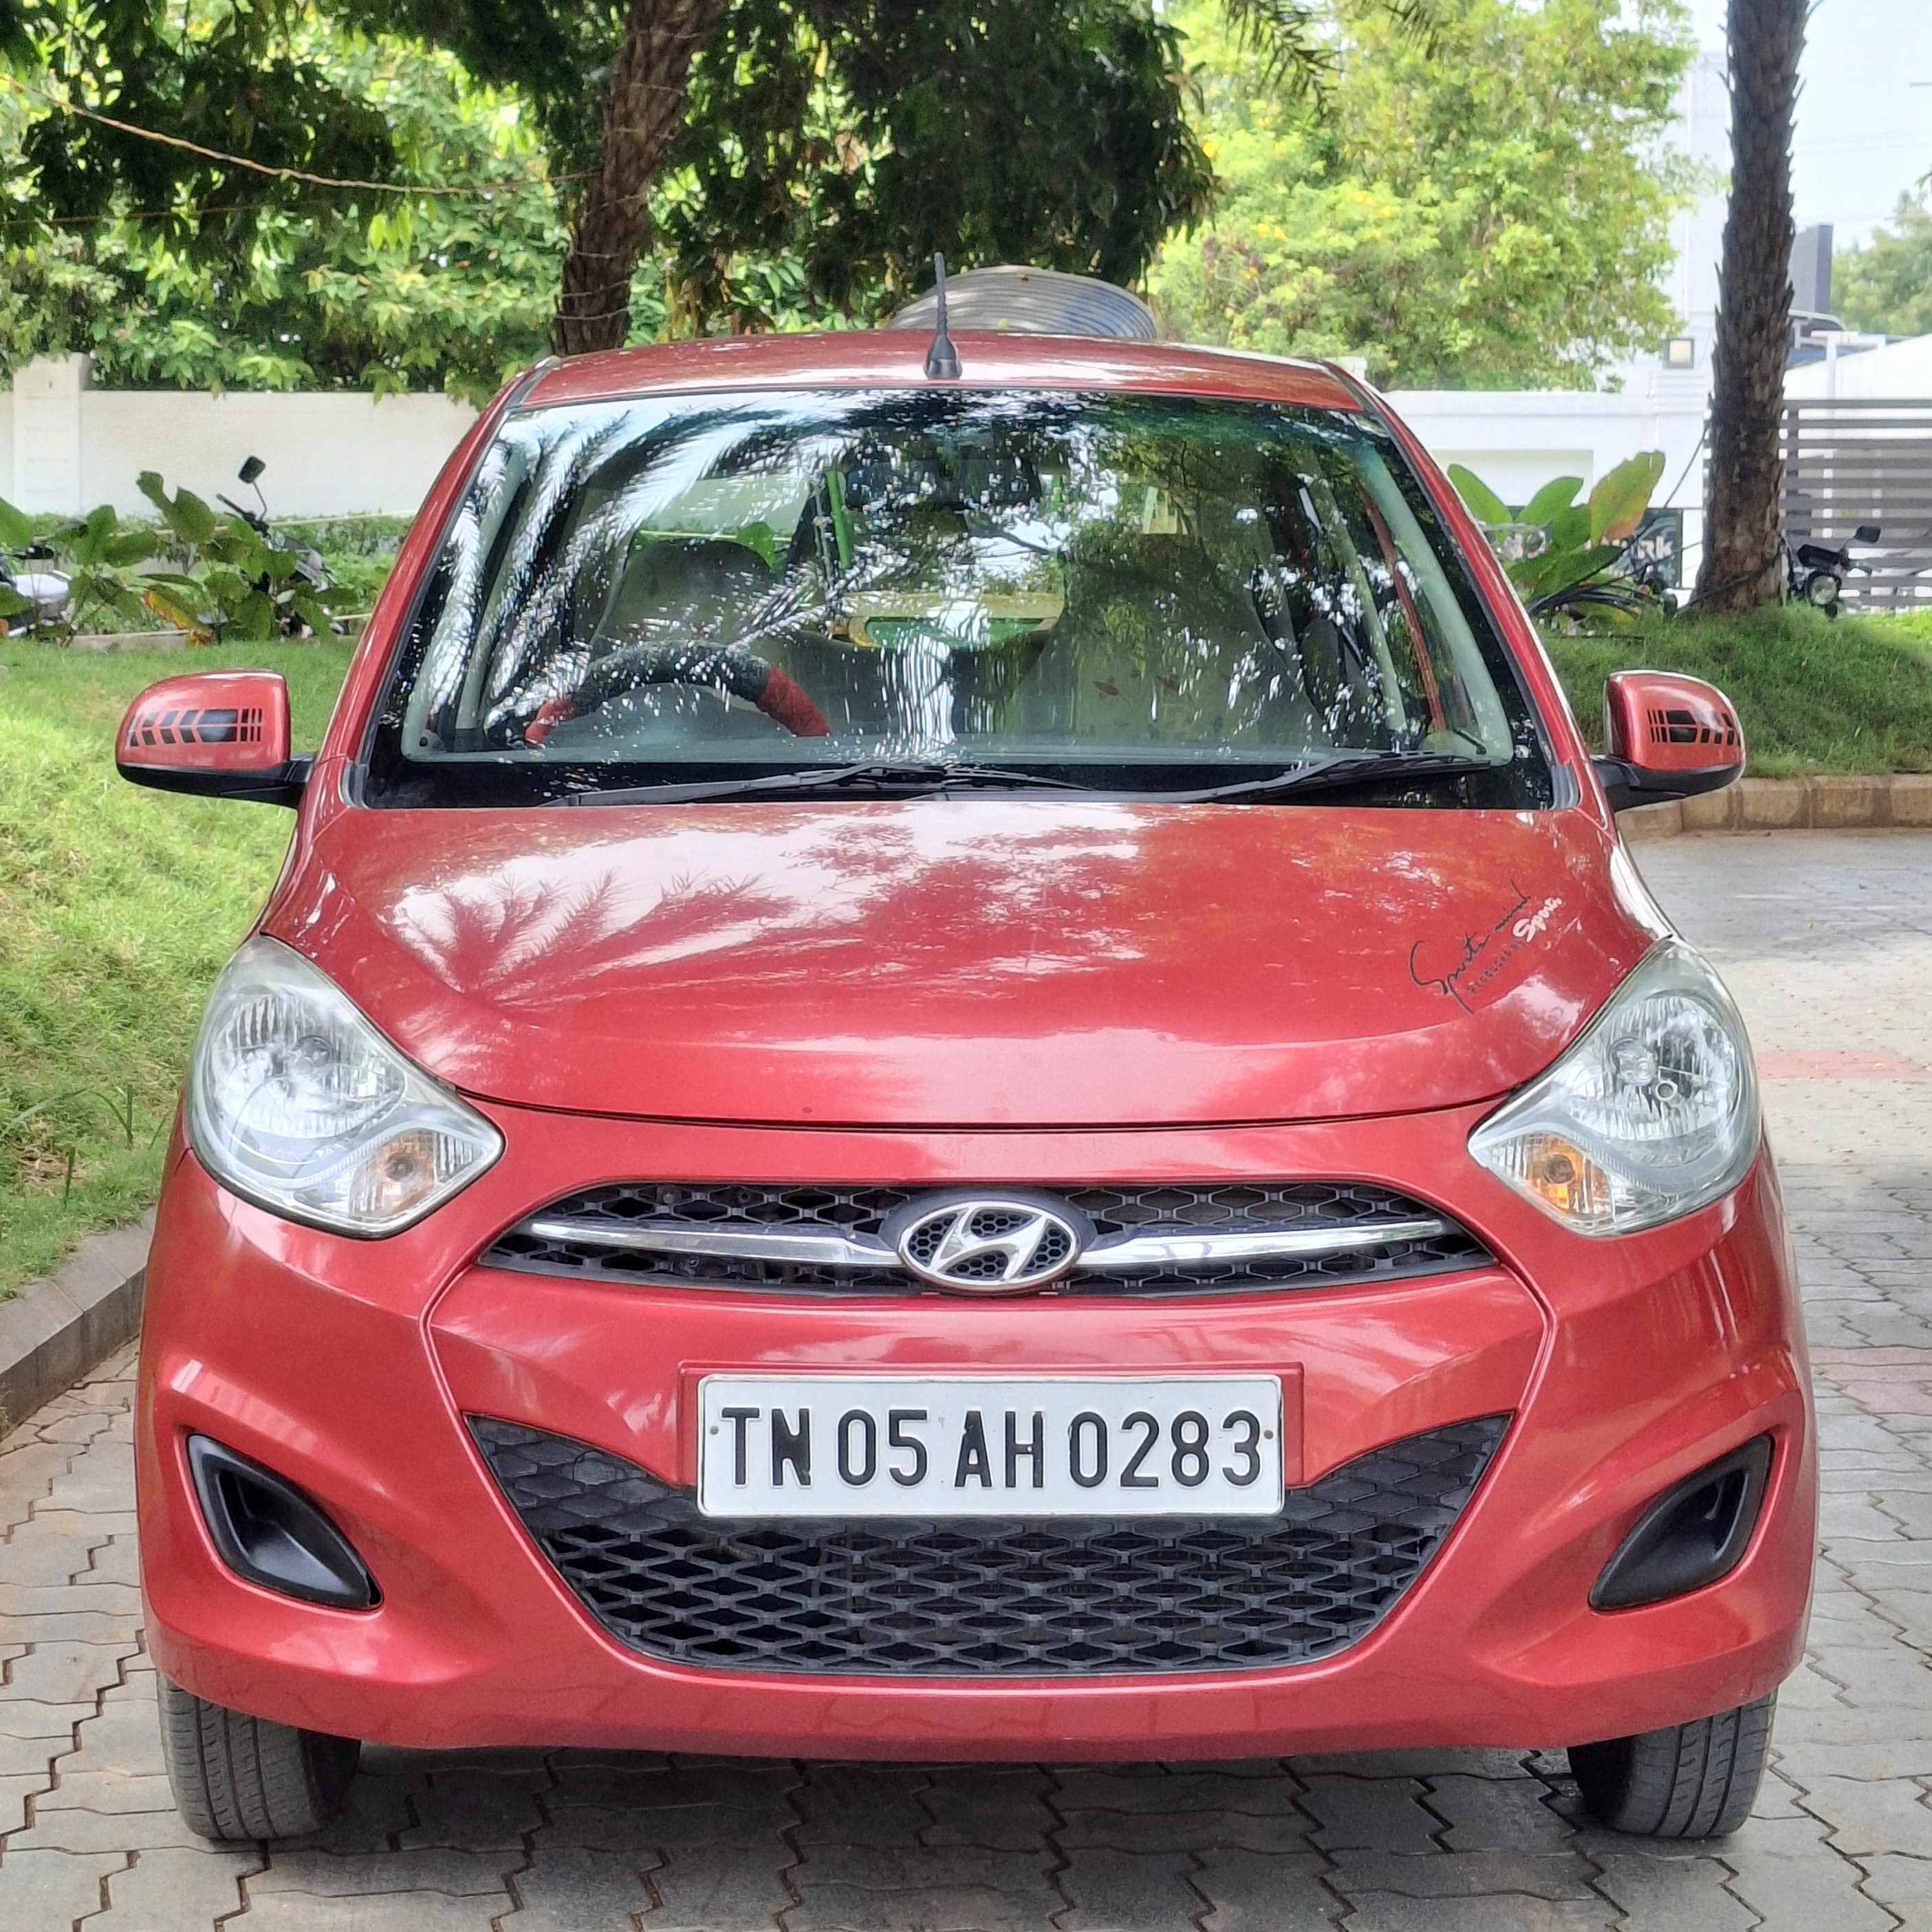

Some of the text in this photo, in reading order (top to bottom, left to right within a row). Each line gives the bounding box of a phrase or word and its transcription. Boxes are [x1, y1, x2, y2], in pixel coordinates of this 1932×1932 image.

[1512, 896, 1563, 943] Sports
[721, 1407, 1261, 1488] TN 05 AH 0283
